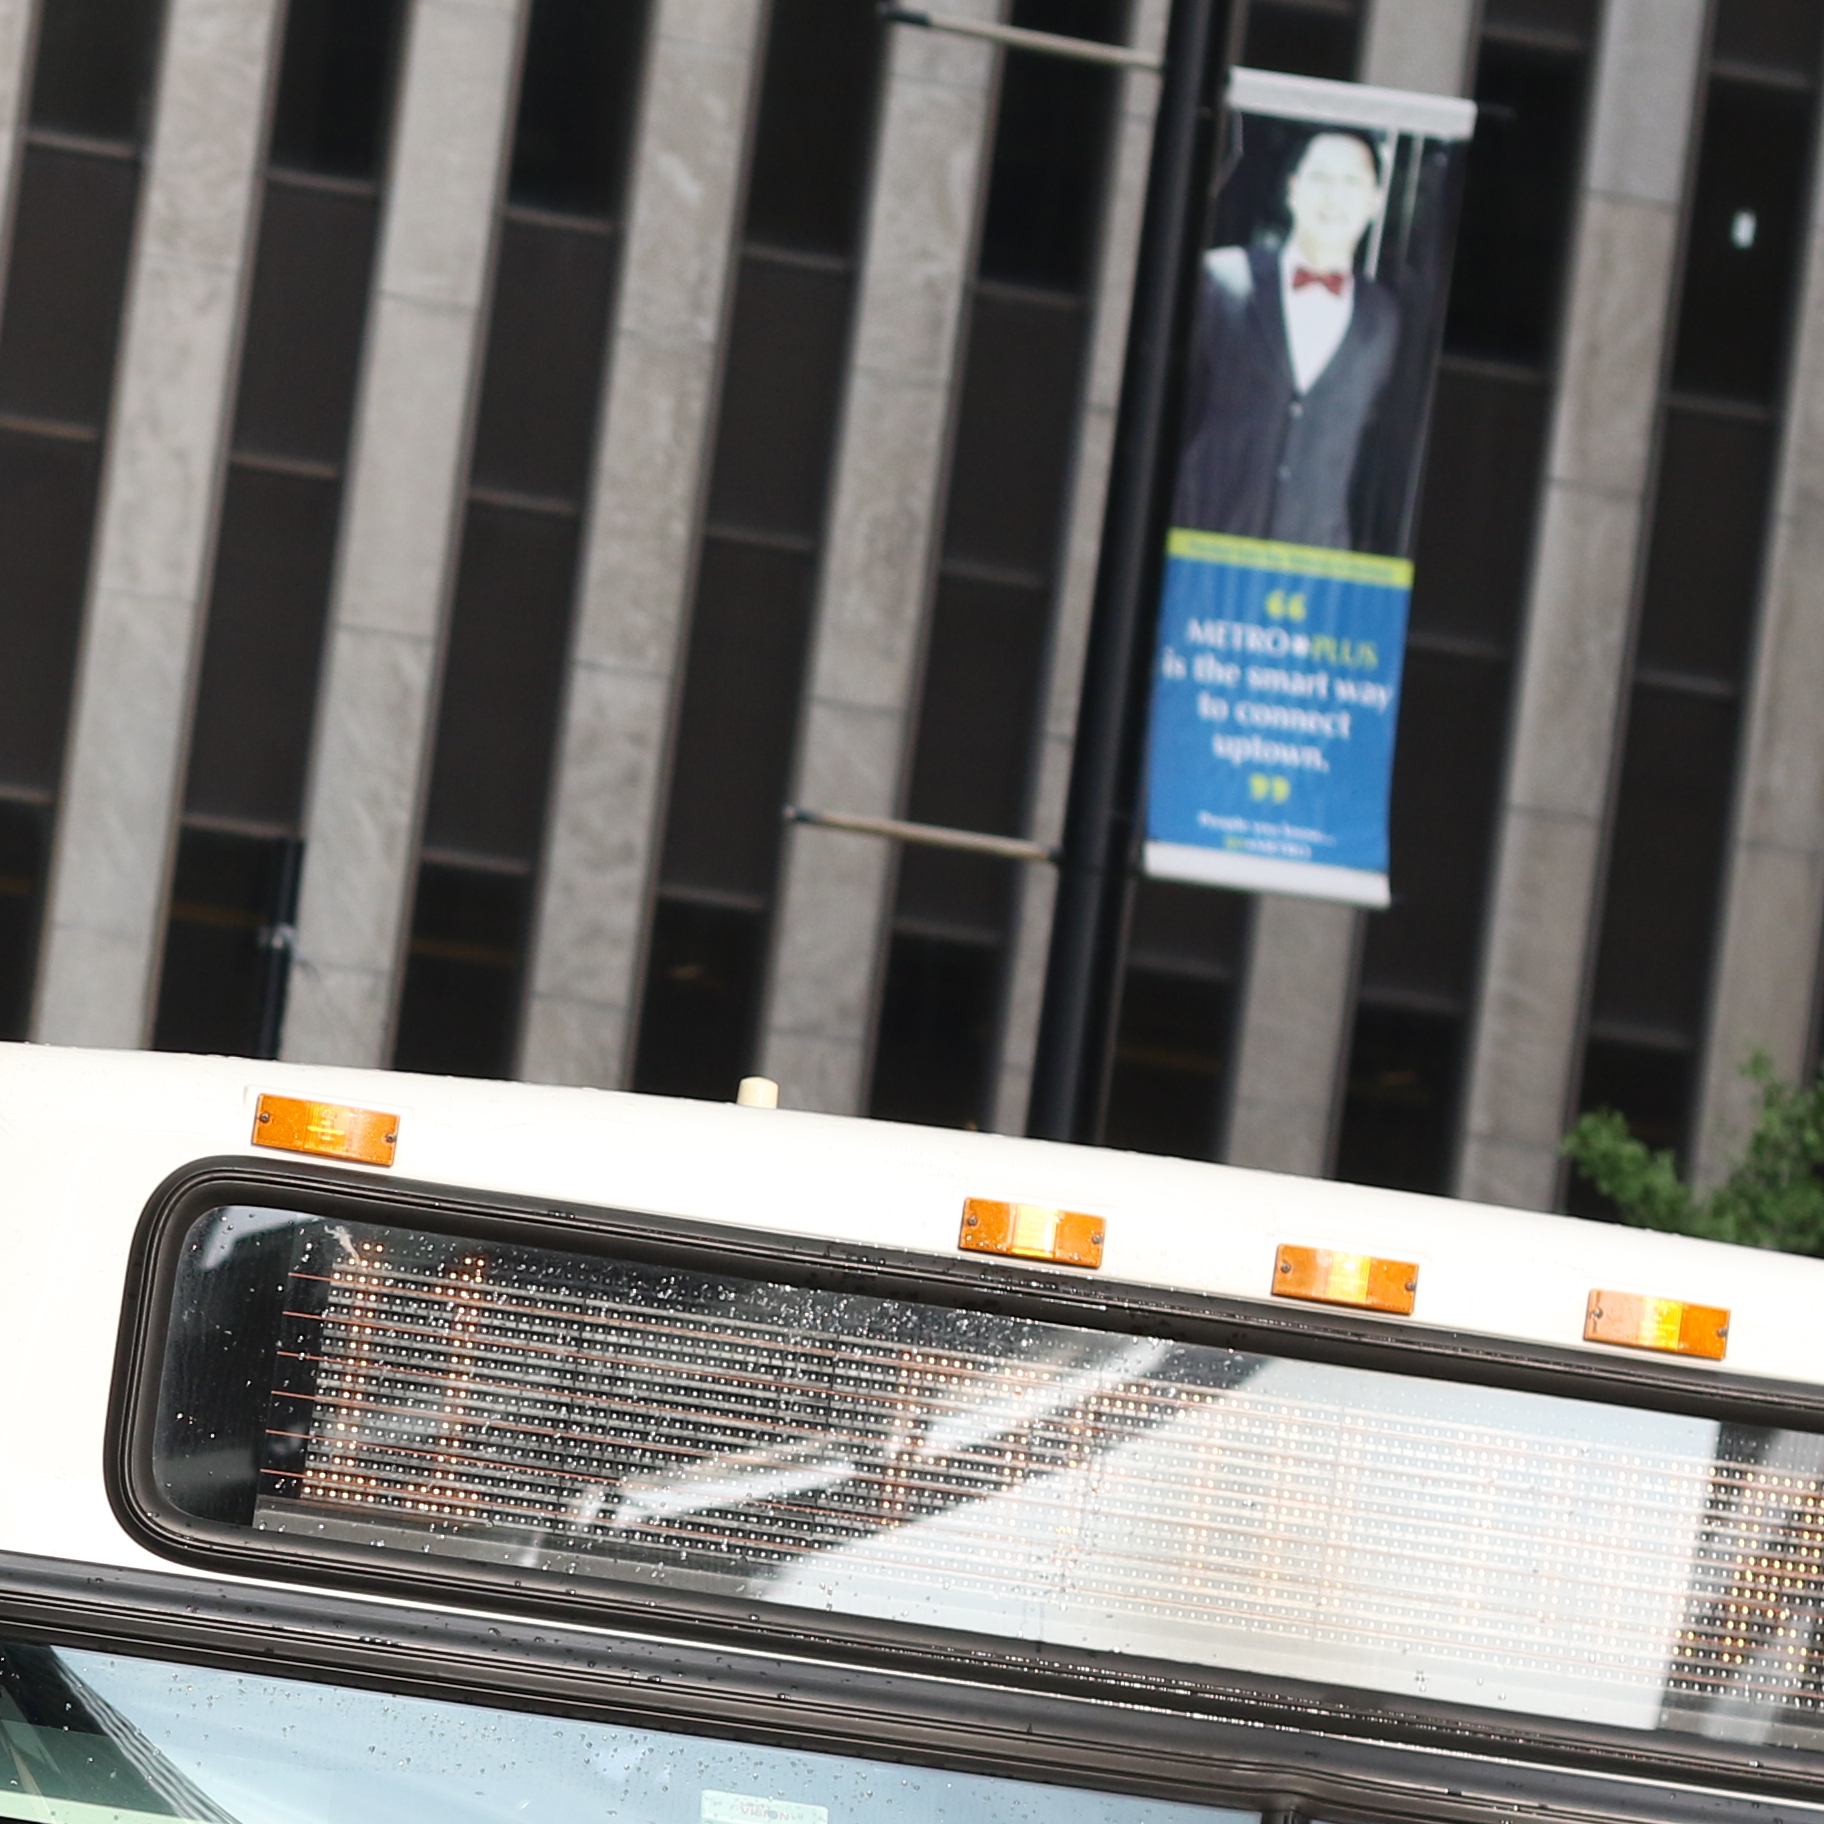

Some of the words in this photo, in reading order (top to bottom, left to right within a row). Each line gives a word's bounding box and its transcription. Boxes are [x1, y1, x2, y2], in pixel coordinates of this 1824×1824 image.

[1162, 647, 1187, 680] is
[1192, 652, 1241, 687] the
[1246, 665, 1329, 699] smart
[1334, 677, 1390, 714] way
[1197, 691, 1229, 721] to
[1234, 699, 1351, 740] connect
[1213, 733, 1330, 772] uptown.
